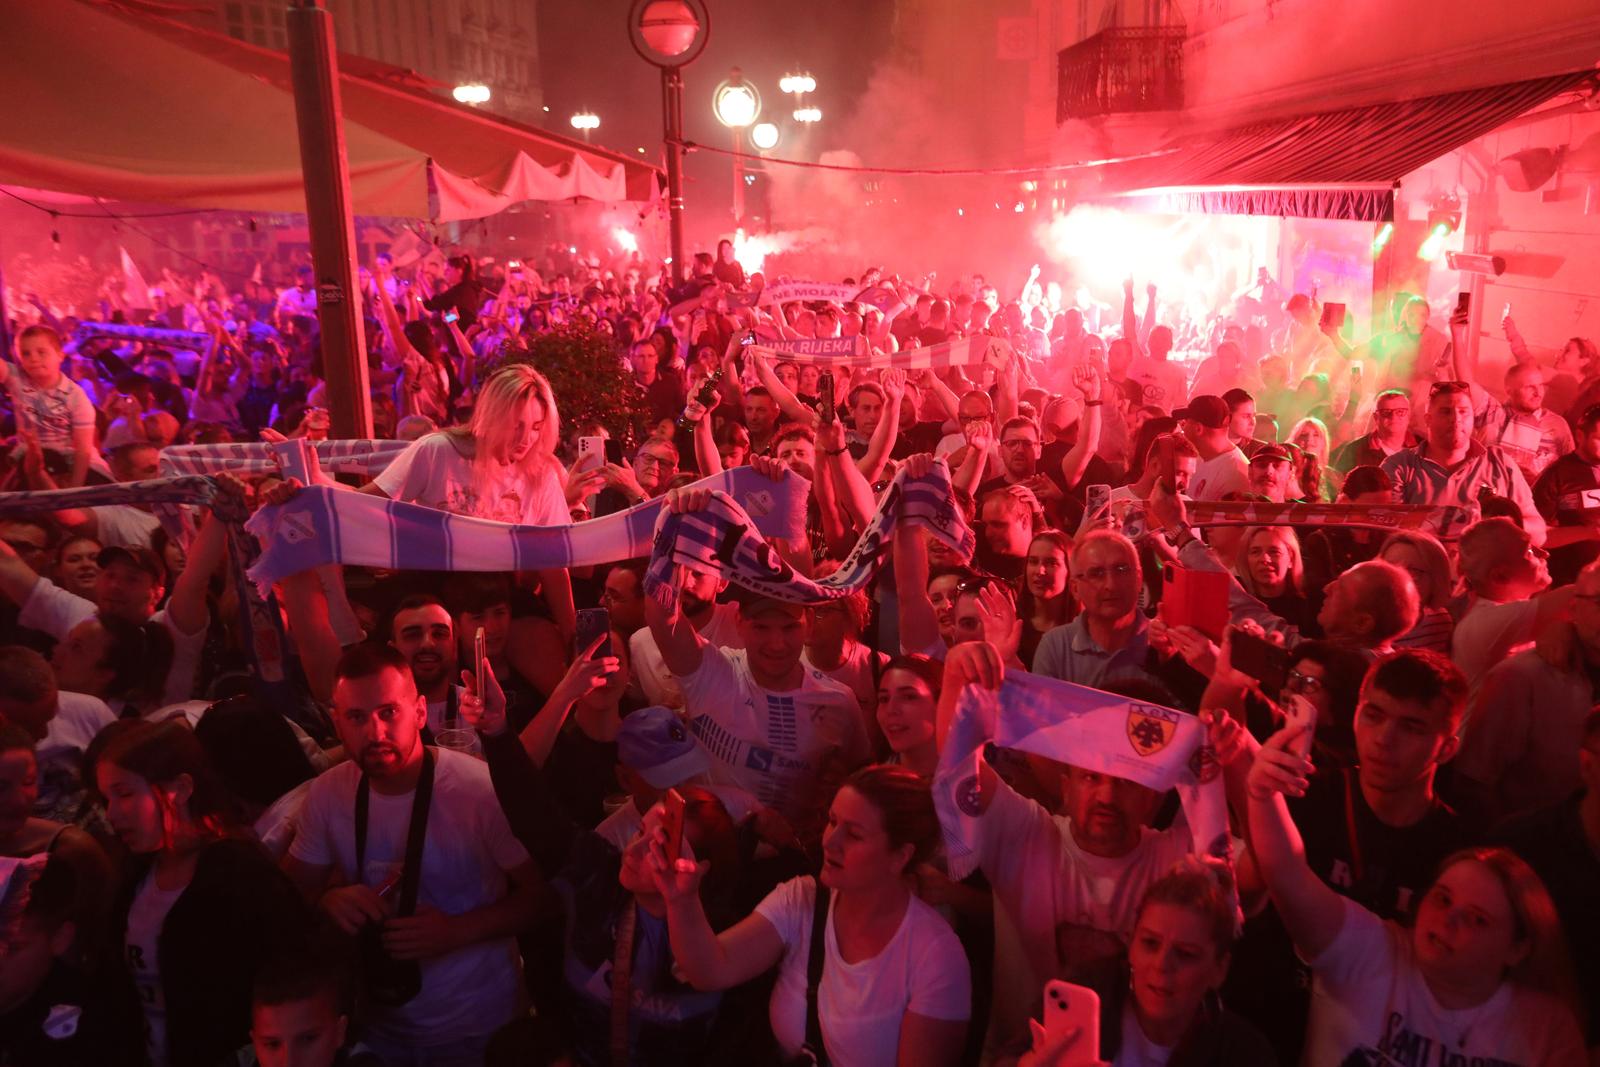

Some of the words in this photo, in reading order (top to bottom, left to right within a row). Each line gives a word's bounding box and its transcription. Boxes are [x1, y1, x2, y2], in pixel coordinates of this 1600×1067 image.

[772, 290, 791, 300] NE
[794, 288, 848, 298] MOLAT
[800, 339, 852, 354] RIJEKA
[729, 571, 795, 600] KREPAT
[777, 757, 811, 770] SAVA
[632, 988, 683, 1021] SAVA
